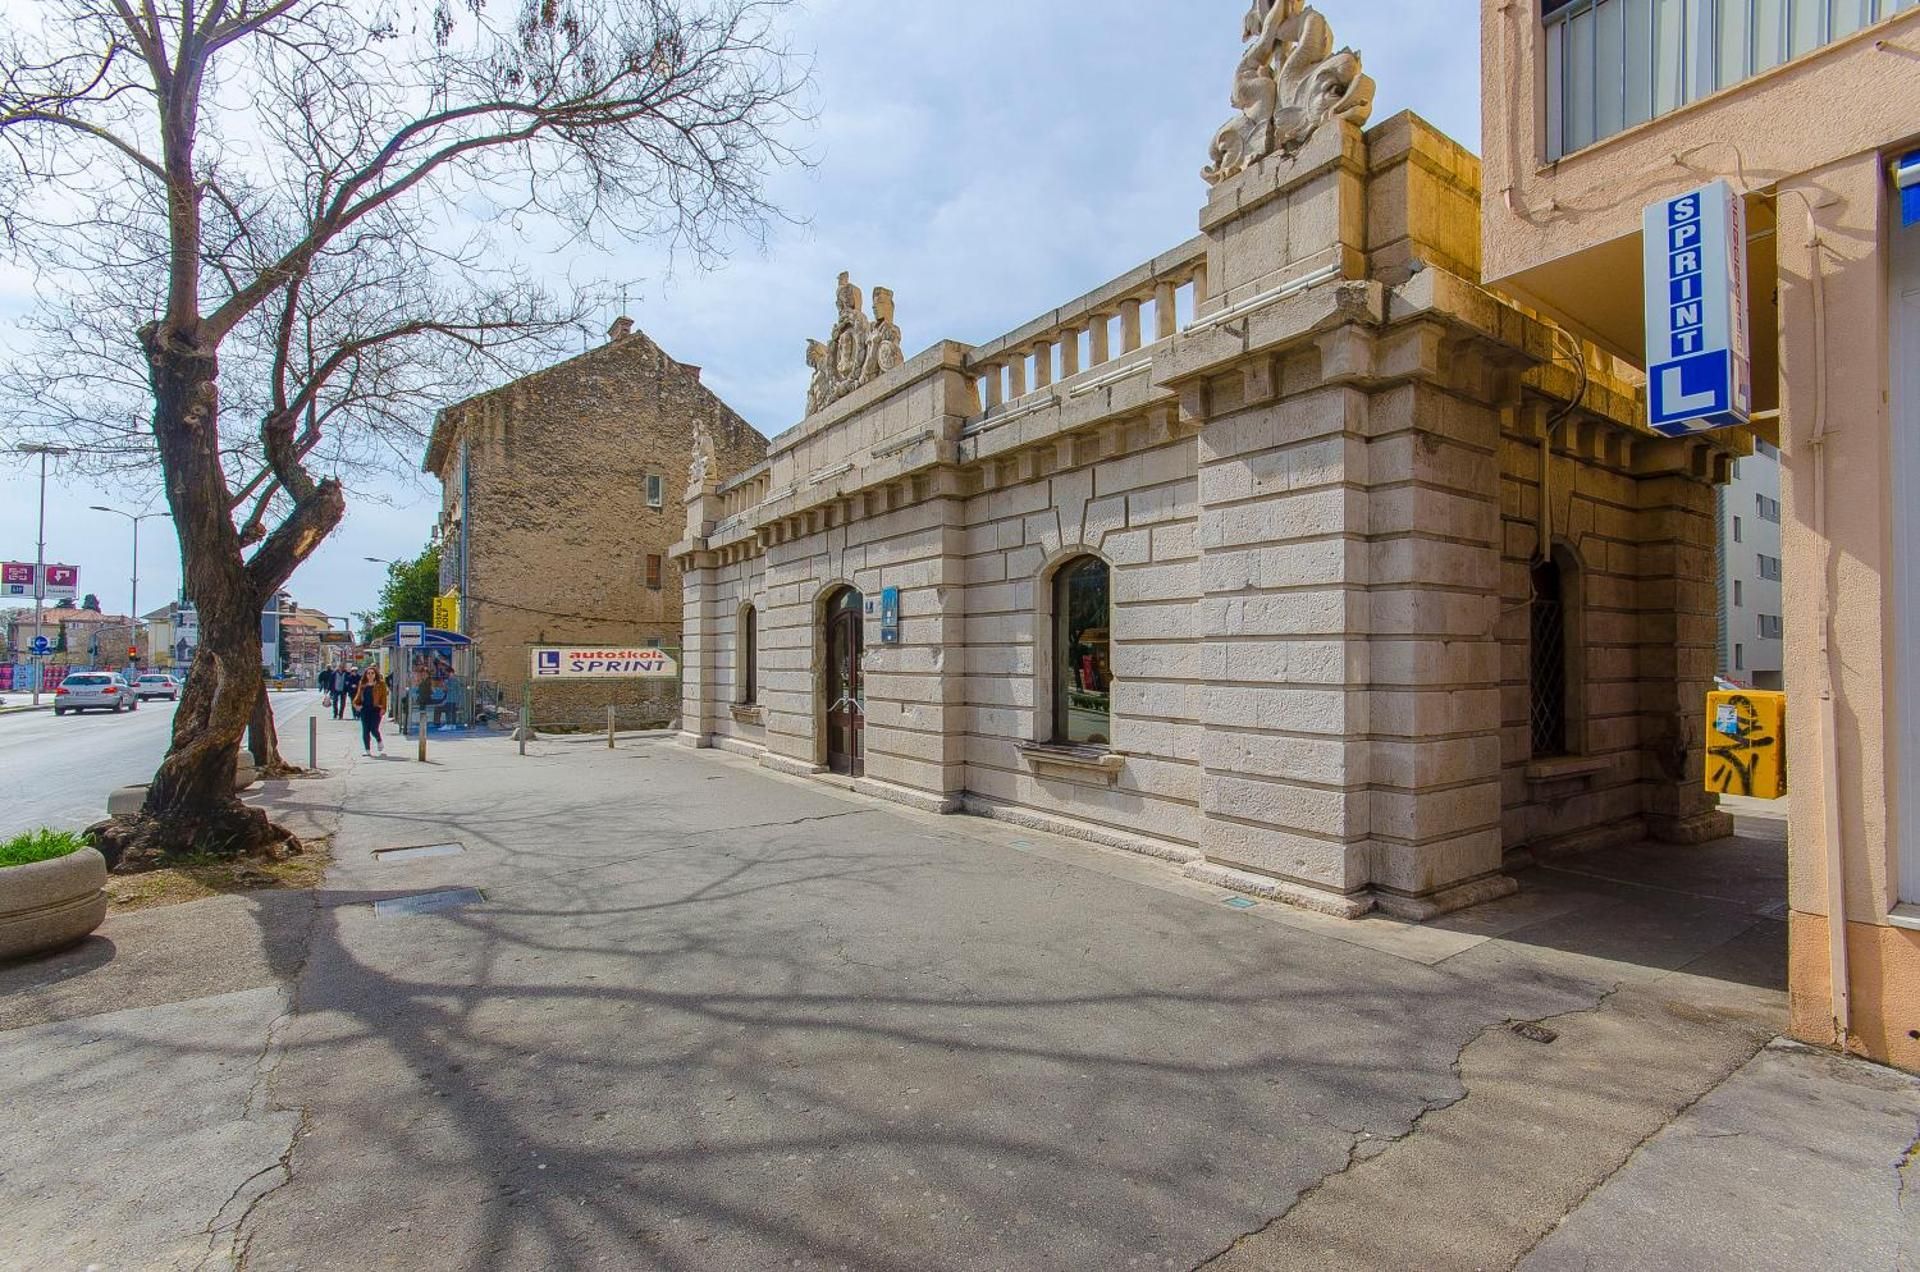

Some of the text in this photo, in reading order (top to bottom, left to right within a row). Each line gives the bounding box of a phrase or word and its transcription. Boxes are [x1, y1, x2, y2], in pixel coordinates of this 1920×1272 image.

[1673, 197, 1698, 353] SPRINT
[1661, 366, 1715, 416] L
[569, 660, 666, 672] SPRINT
